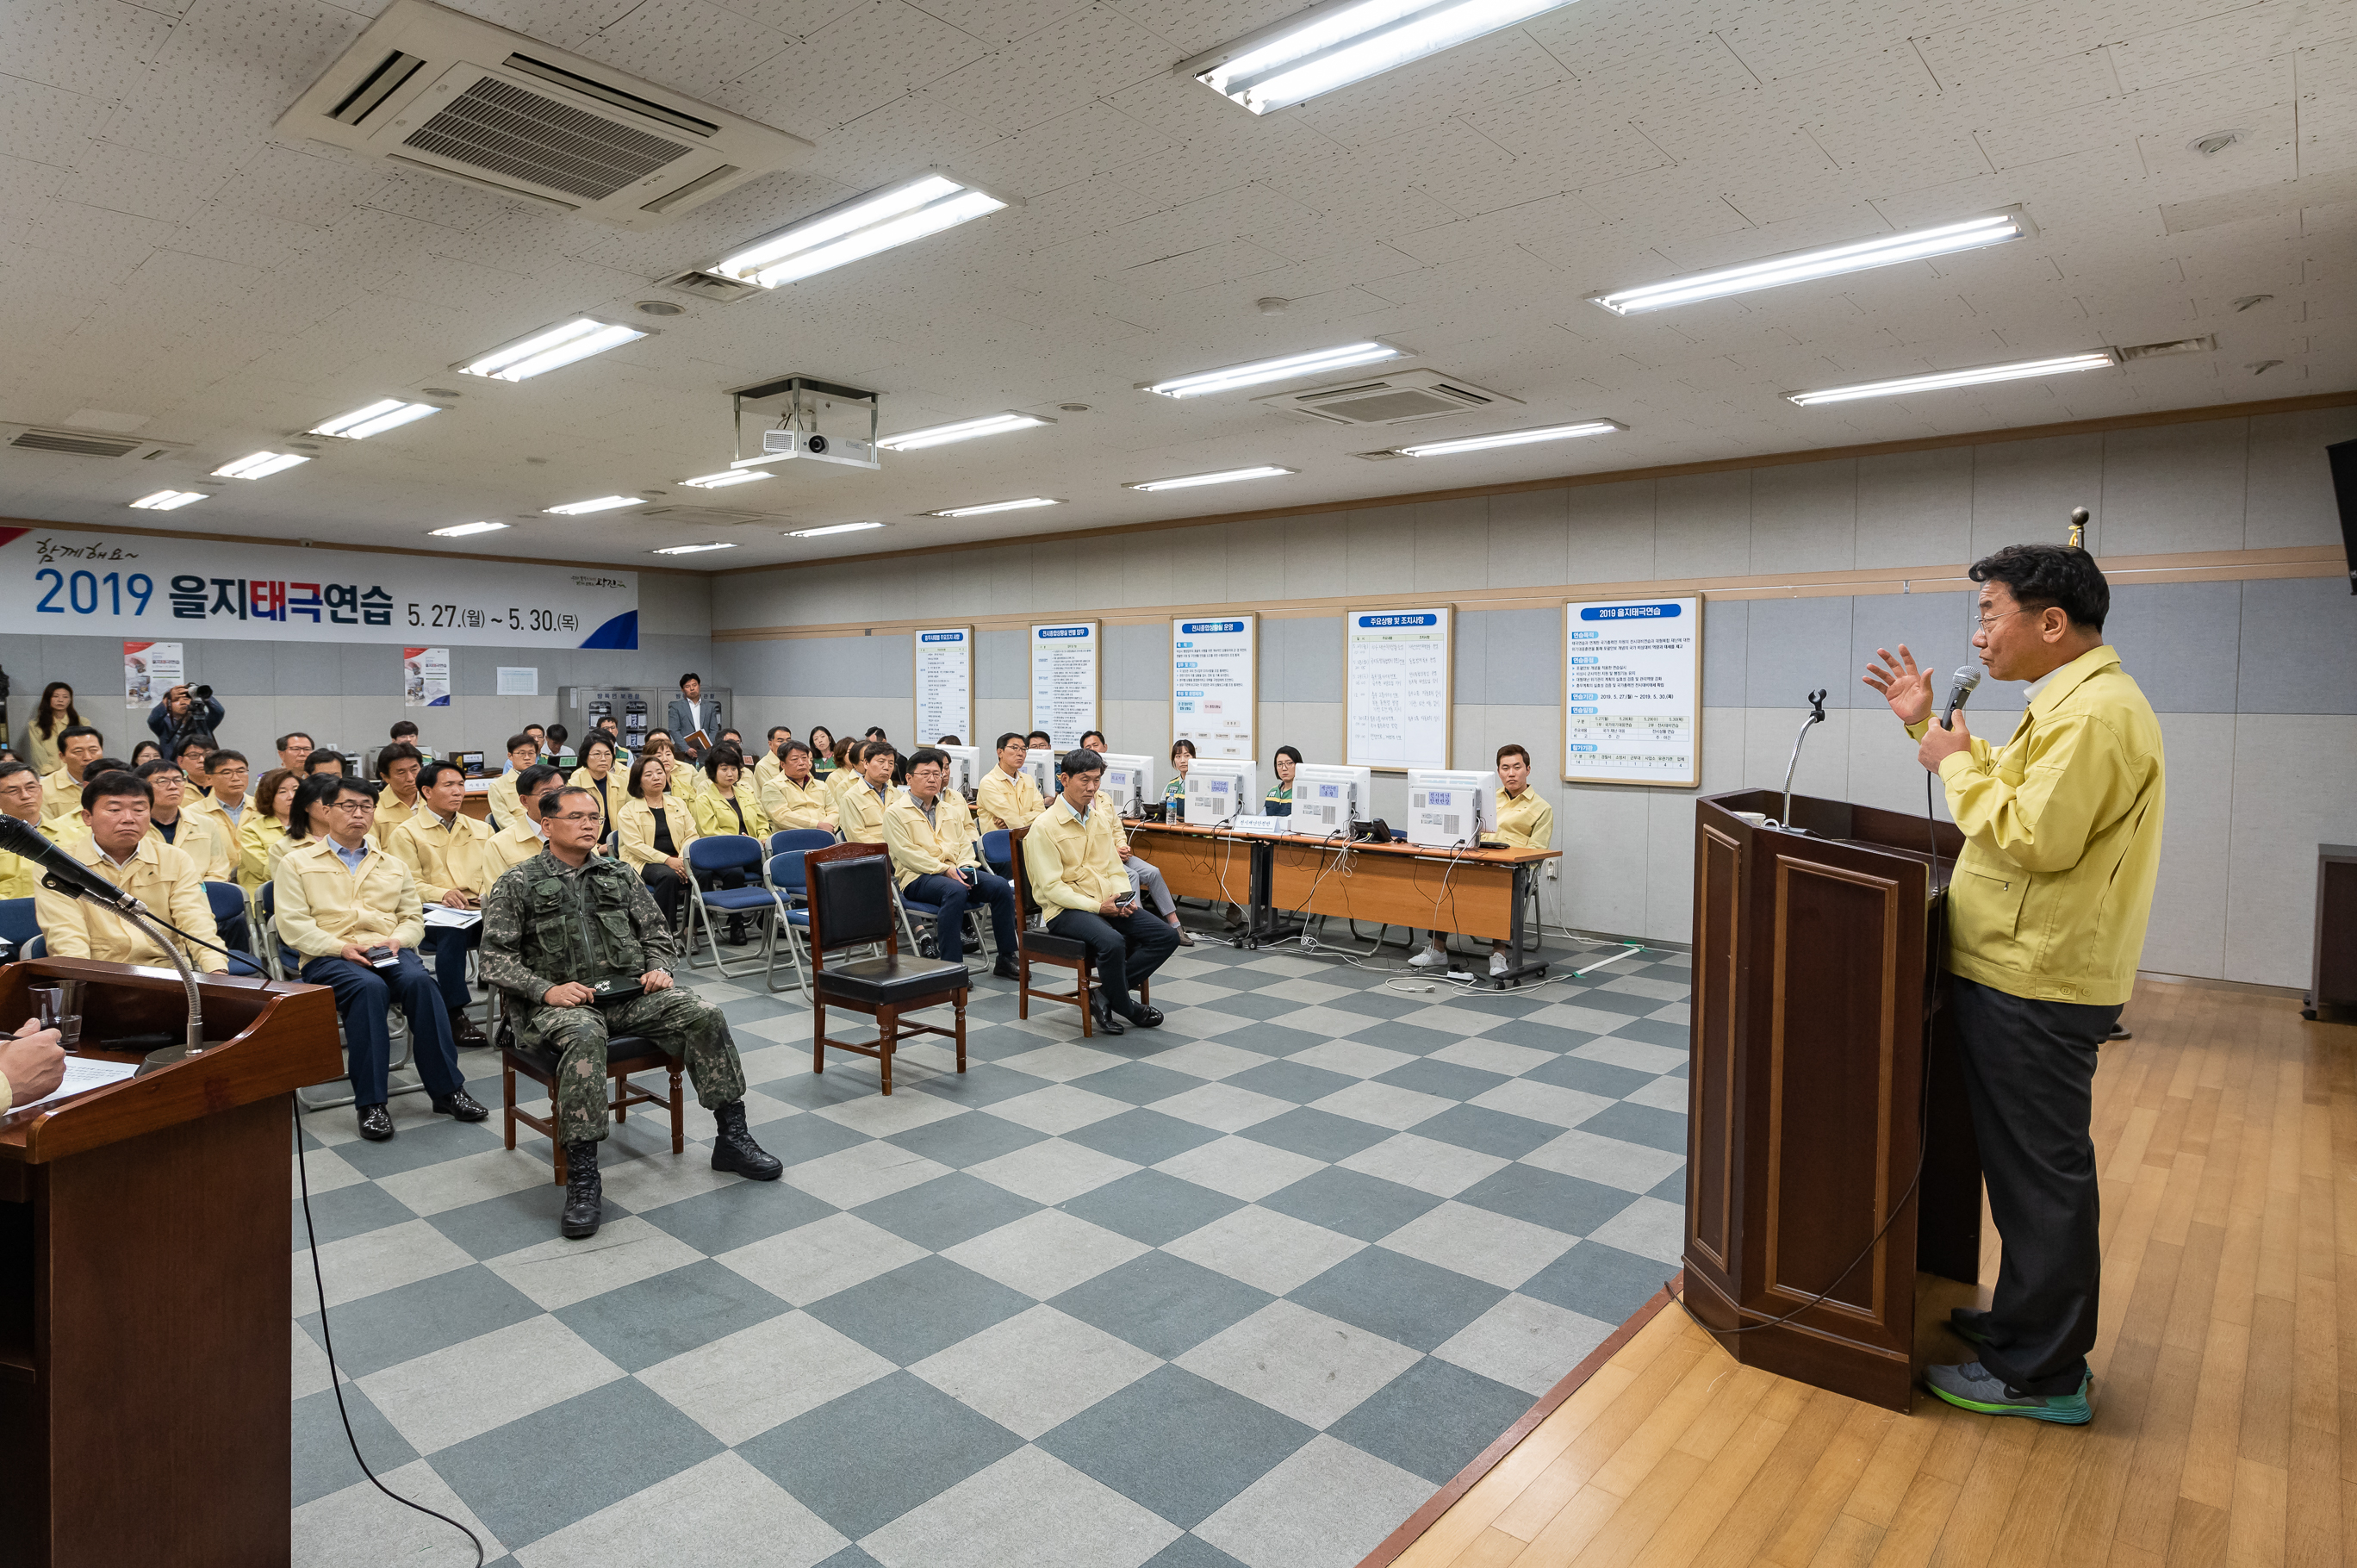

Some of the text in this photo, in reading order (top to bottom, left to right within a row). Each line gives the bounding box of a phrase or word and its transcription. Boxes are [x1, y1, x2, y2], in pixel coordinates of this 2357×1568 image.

[35, 568, 153, 616] 2019
[169, 575, 394, 625] 을지태극연습
[408, 603, 425, 627] 5.
[432, 604, 485, 628] 27.(월)
[509, 608, 525, 631] 5.
[530, 609, 579, 632] 30.(목)
[1599, 607, 1660, 617] 2019 을지태극연습
[1370, 617, 1392, 625] 주요상황
[1401, 616, 1424, 625] 조치사항
[1192, 624, 1223, 632] 전시종합상황실
